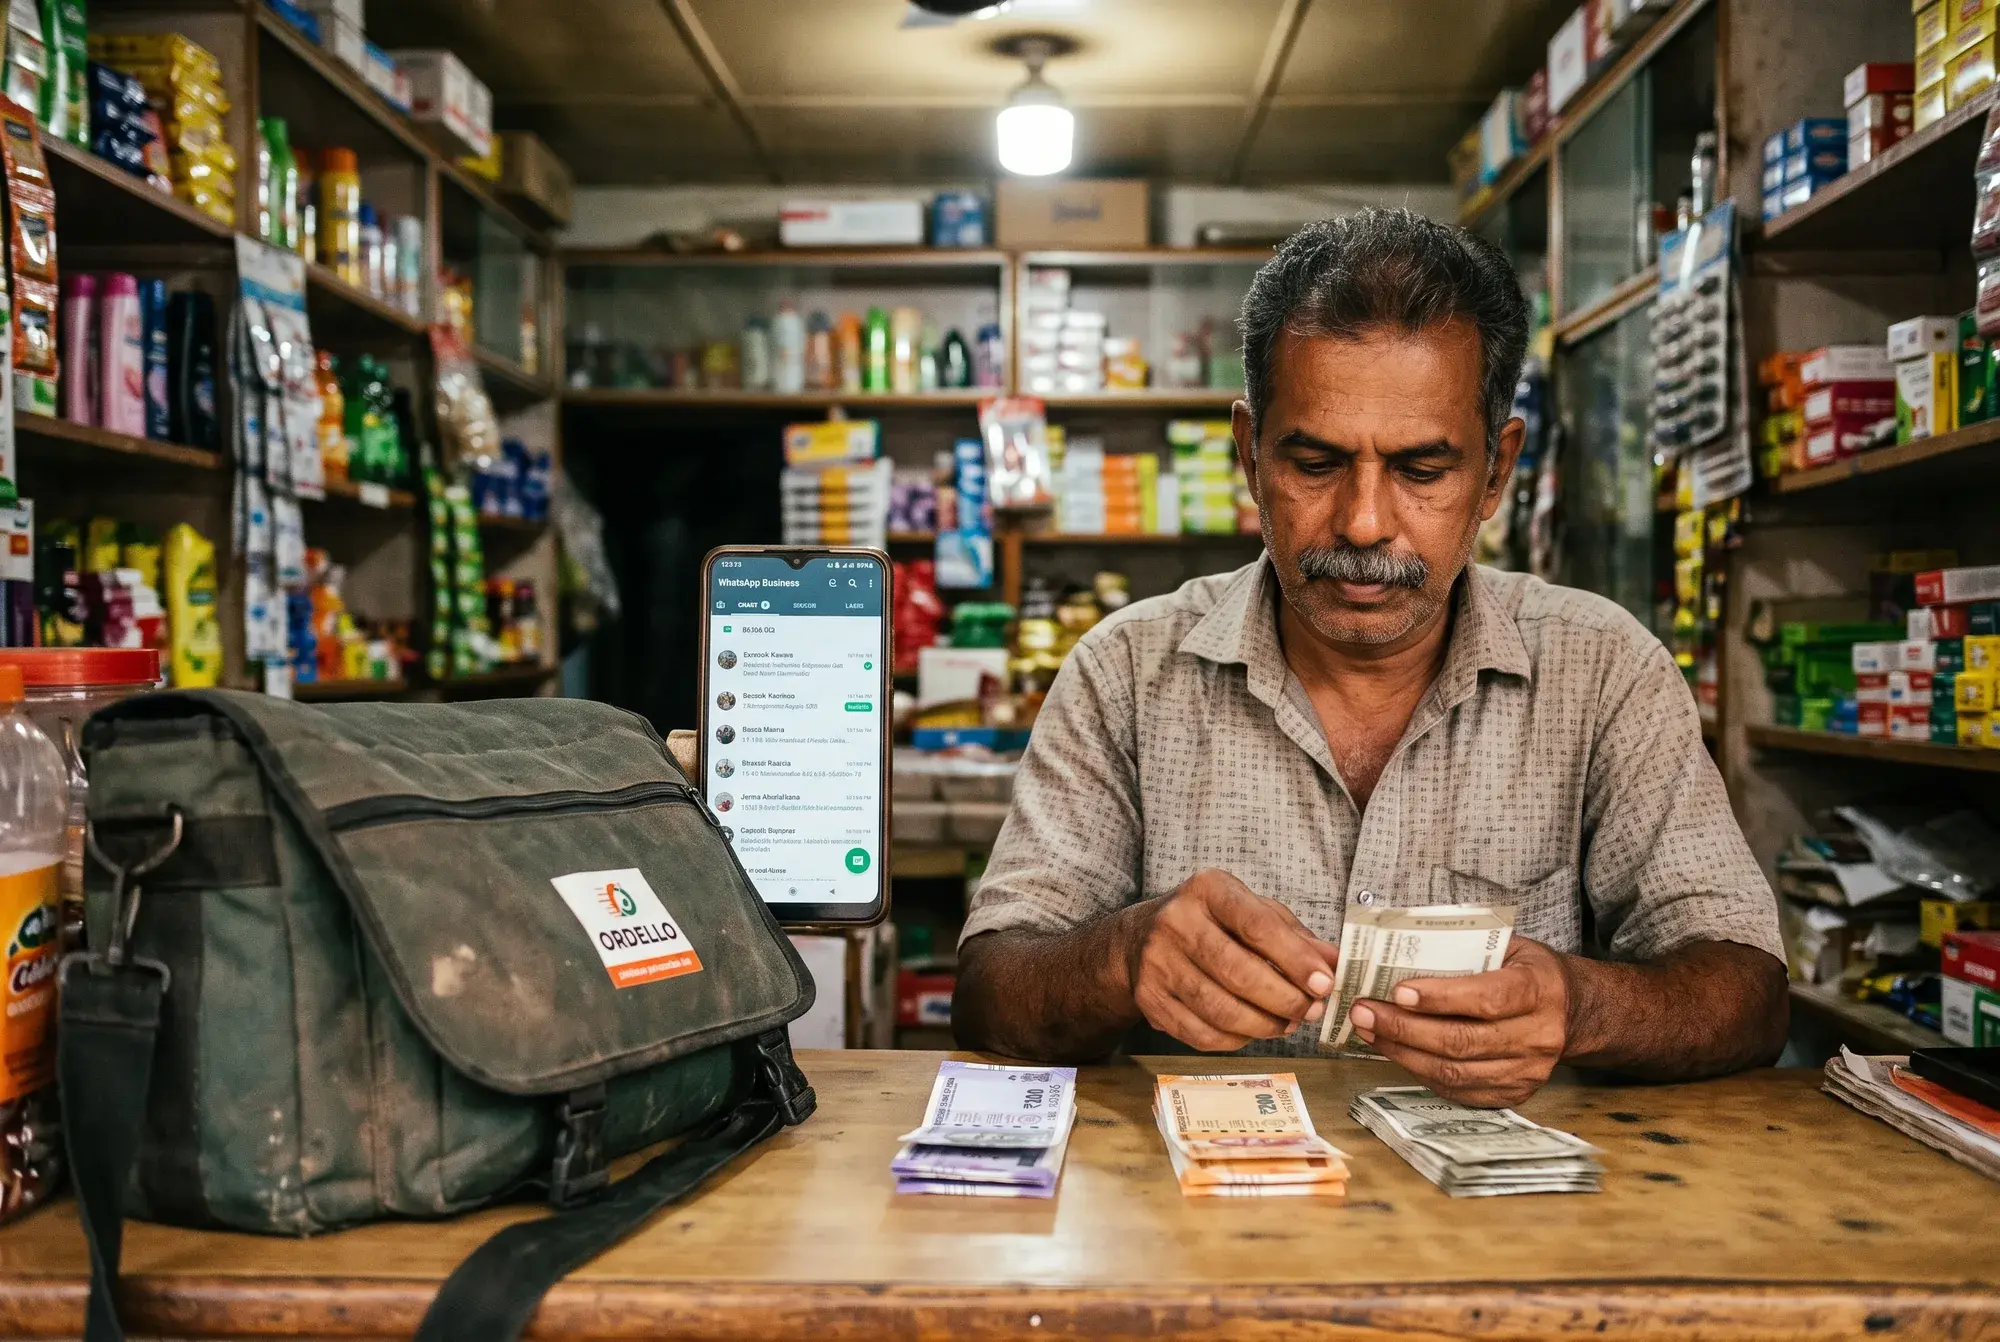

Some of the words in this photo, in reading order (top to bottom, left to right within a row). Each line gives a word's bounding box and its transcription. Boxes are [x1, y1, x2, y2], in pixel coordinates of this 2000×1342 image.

[718, 578, 760, 588] WhatsApp
[762, 578, 800, 587] Business
[599, 922, 677, 951] ORDELLO
